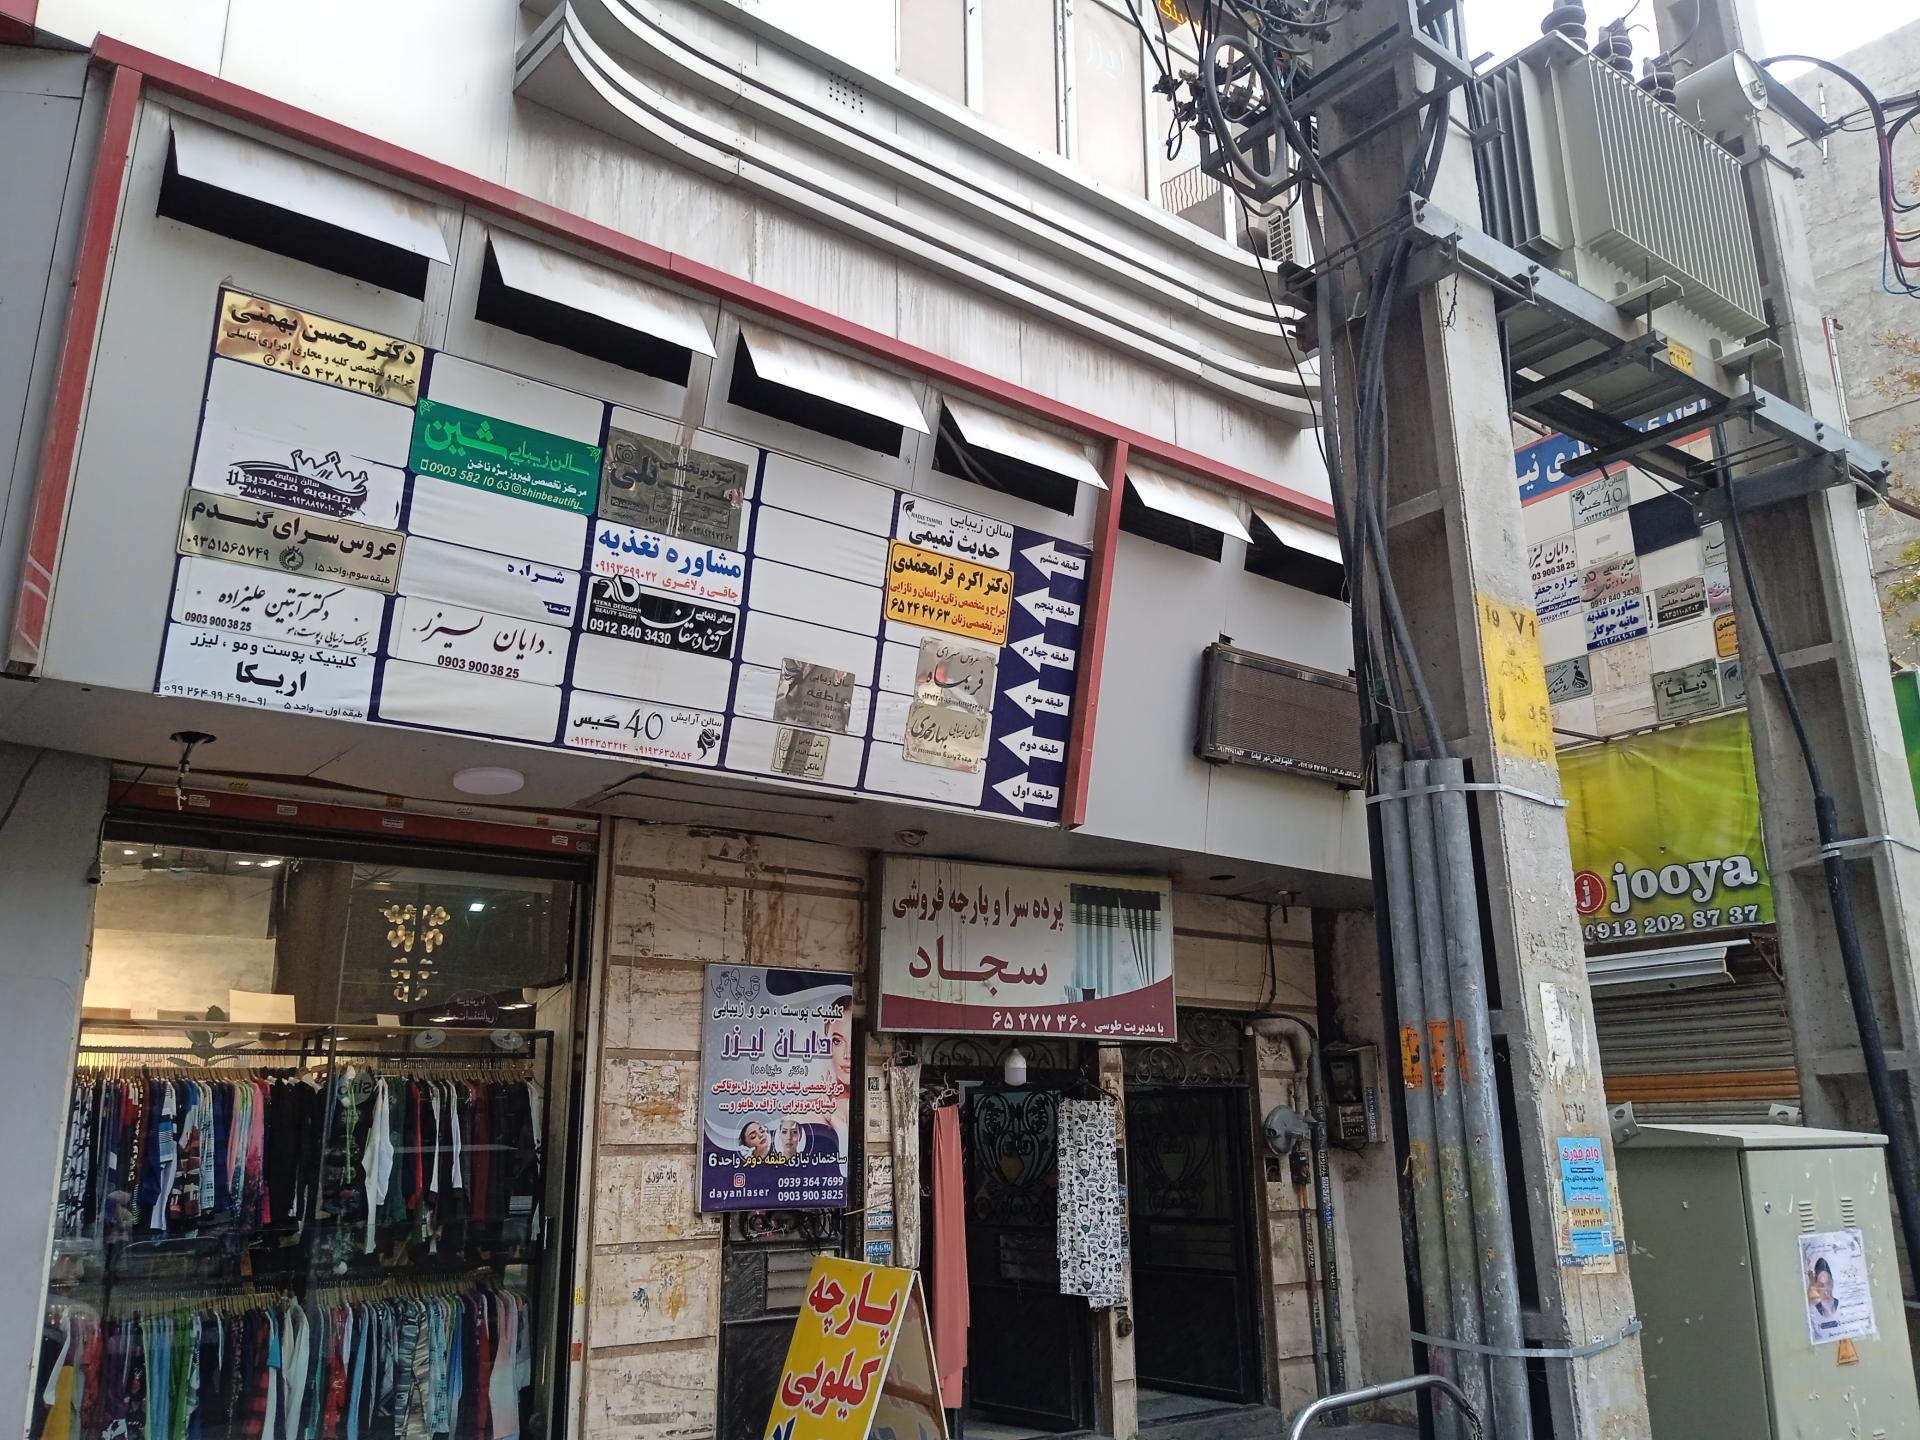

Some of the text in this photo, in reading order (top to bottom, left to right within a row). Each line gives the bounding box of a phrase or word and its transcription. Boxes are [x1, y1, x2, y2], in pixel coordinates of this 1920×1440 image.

[226, 328, 257, 342] تناسلی
[231, 306, 416, 365] دکتر محسن بهمنی
[258, 337, 291, 352] ادراری
[292, 346, 322, 360] مجاری
[325, 355, 329, 364] و
[331, 356, 349, 367] کلیه
[280, 361, 310, 376] ۰۹۰۵
[315, 368, 344, 384] ۴۳۸
[425, 420, 507, 461] شین
[429, 462, 457, 478] 0903
[459, 470, 480, 484] 582
[496, 480, 510, 491] 63
[531, 477, 562, 490] تخصصی
[562, 484, 587, 497] مرکز
[1578, 488, 1624, 515] 40 گیس
[191, 500, 397, 560] عروس سرای گندم
[950, 514, 984, 535] زیبایی
[986, 523, 1012, 539] سالن
[599, 529, 742, 578] مشاوره تغذیه
[908, 529, 1000, 560] حدیث تمیمی
[1545, 542, 1568, 564] دایان
[314, 562, 391, 585] طبقه ۱۵
[1061, 558, 1080, 571] طبقه
[662, 578, 698, 592] لاغری
[957, 570, 1009, 595] دکتر اکرم
[1555, 573, 1578, 591] شراره
[218, 585, 266, 613] علیزاده
[890, 581, 1007, 618] جراح متخصص زایمان نازایی
[890, 598, 905, 613] ۶۵
[1590, 599, 1606, 609] 0912
[1608, 593, 1621, 603] 840
[1623, 586, 1640, 598] 3430
[1034, 601, 1075, 617] طبقه پنجم
[1587, 608, 1609, 624] تغذیه
[1611, 600, 1640, 617] مشاوره
[184, 611, 208, 625] 0903
[951, 613, 967, 628] زنان
[966, 617, 992, 629] تخصصی
[420, 612, 545, 661] دایان لیزر
[590, 618, 672, 645] 0912 840 3430
[992, 624, 1005, 636] لیزر
[1592, 615, 1639, 640] هانیه جوکار
[191, 632, 358, 670] کلینیک پوست لیزر
[1022, 646, 1069, 663] طبقه چهارم
[437, 655, 466, 669] 0903
[235, 661, 307, 697] اریکا
[1665, 679, 1708, 698] دیانا
[1025, 693, 1064, 708] طبقه سوم
[283, 702, 363, 719] طبقه اول واحد ۵
[573, 708, 664, 740] 40 گیس
[670, 712, 722, 728] سالن آرایش
[1019, 740, 1059, 755] طبقه دوم
[1012, 787, 1053, 800] طبقه اول
[1610, 855, 1759, 914] jooya
[892, 879, 1064, 932] پرده سرا و پارچه فروشی
[1585, 905, 1759, 940] 0912 202 87 37
[909, 935, 1048, 996] سجاد
[713, 1001, 844, 1023] کلینیک پوست مو و زیبایی
[992, 1010, 1164, 1036] با مدیریت طوسی ۶۵ ۲۷۷ ۳۶۰
[721, 1025, 833, 1058] دایان لیزر
[802, 1081, 827, 1094] تخصصی
[828, 1082, 844, 1095] مرکز
[708, 1152, 848, 1168] ساختمان نیازی طبقه دوم واحد 6
[778, 1176, 844, 1188] 0939 364 7699
[709, 1187, 770, 1200] dayanlaser
[778, 1189, 844, 1202] 0903 900 3825
[808, 1271, 899, 1347] پارچه
[781, 1350, 882, 1419] کیلویی
